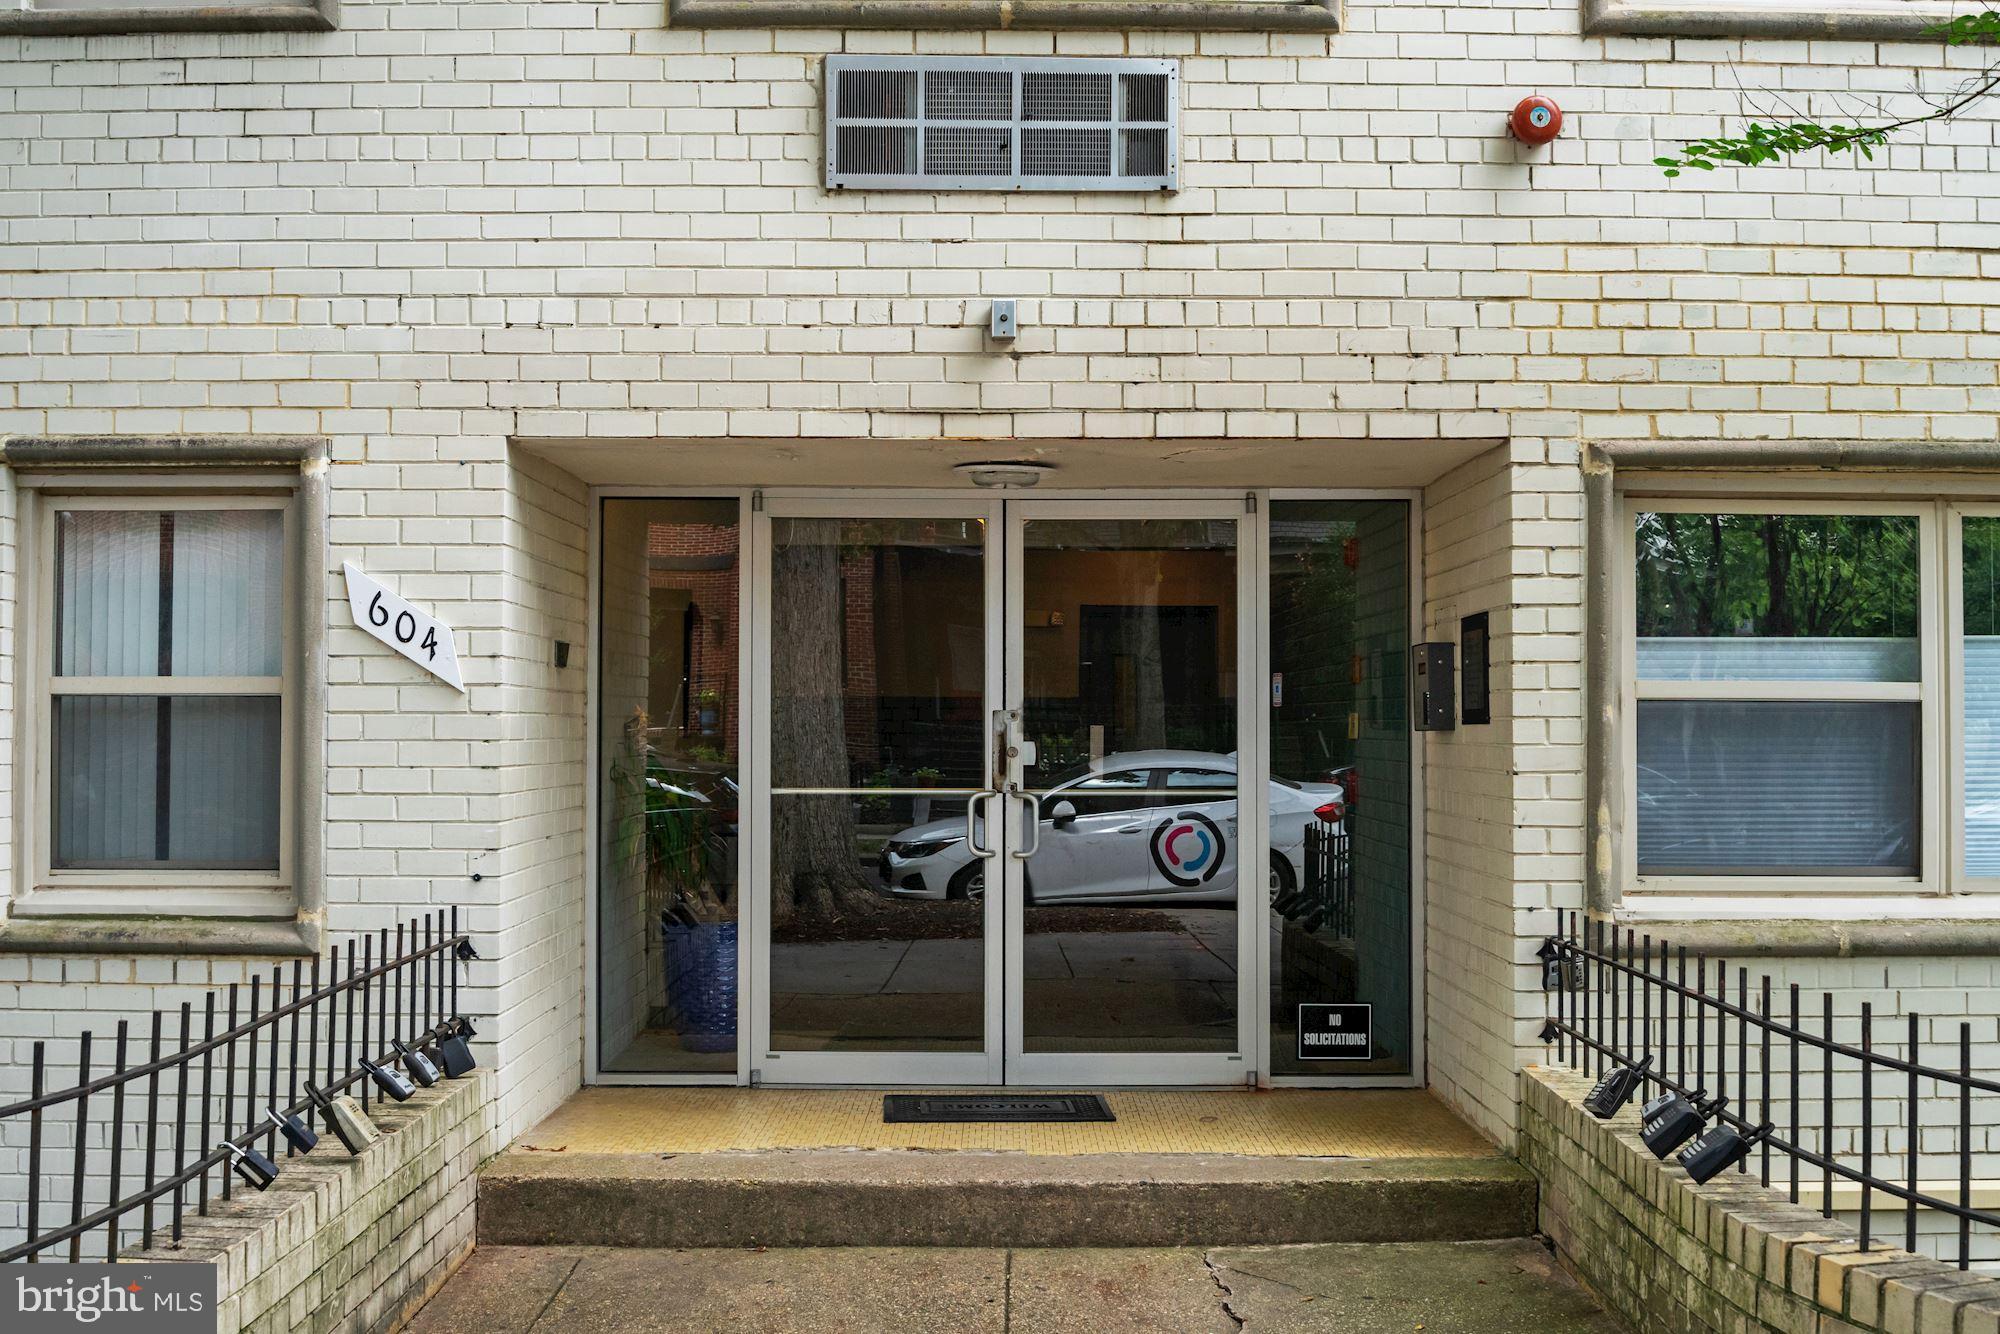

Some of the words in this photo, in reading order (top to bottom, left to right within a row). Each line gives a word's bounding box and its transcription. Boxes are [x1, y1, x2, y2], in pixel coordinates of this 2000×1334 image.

[369, 590, 438, 662] 604
[1328, 1013, 1342, 1027] NO
[1303, 1032, 1367, 1046] SOLICITATIONS
